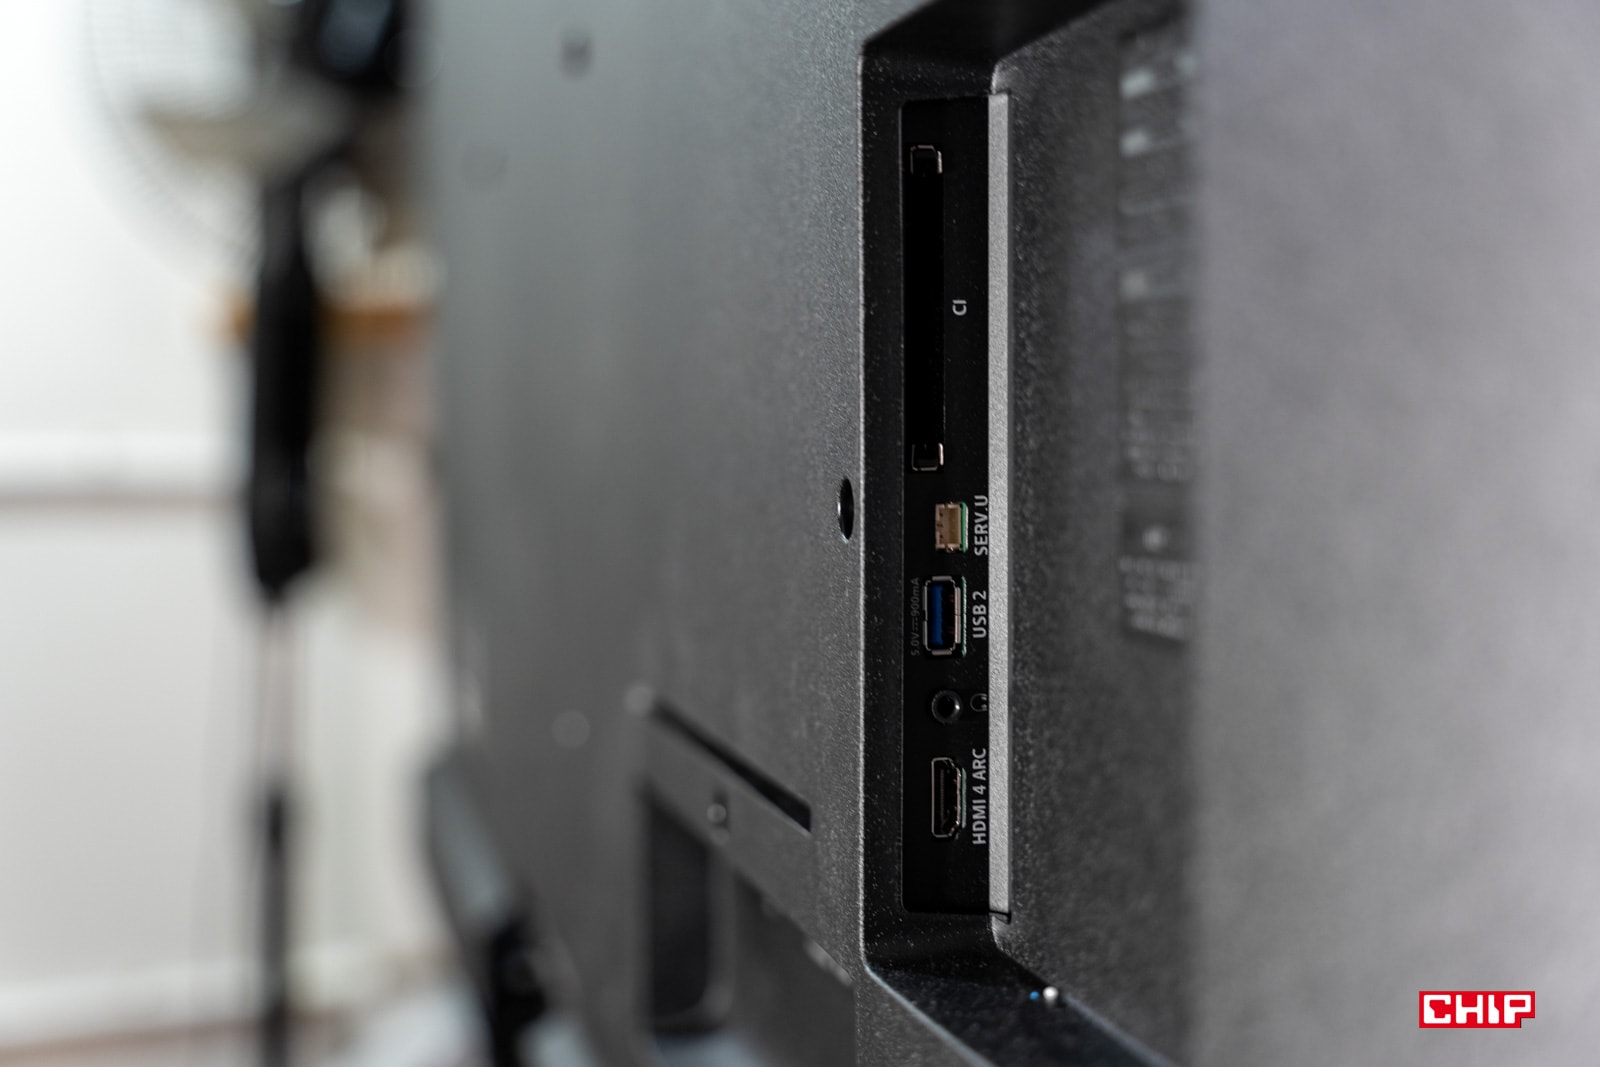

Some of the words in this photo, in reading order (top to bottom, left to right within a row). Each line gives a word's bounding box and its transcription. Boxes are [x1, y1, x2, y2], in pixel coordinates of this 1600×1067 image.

[952, 299, 967, 316] CI
[973, 590, 987, 600] 2
[973, 604, 987, 638] USB
[972, 748, 987, 782] ARC
[974, 784, 987, 795] 4
[972, 799, 987, 845] HDMI
